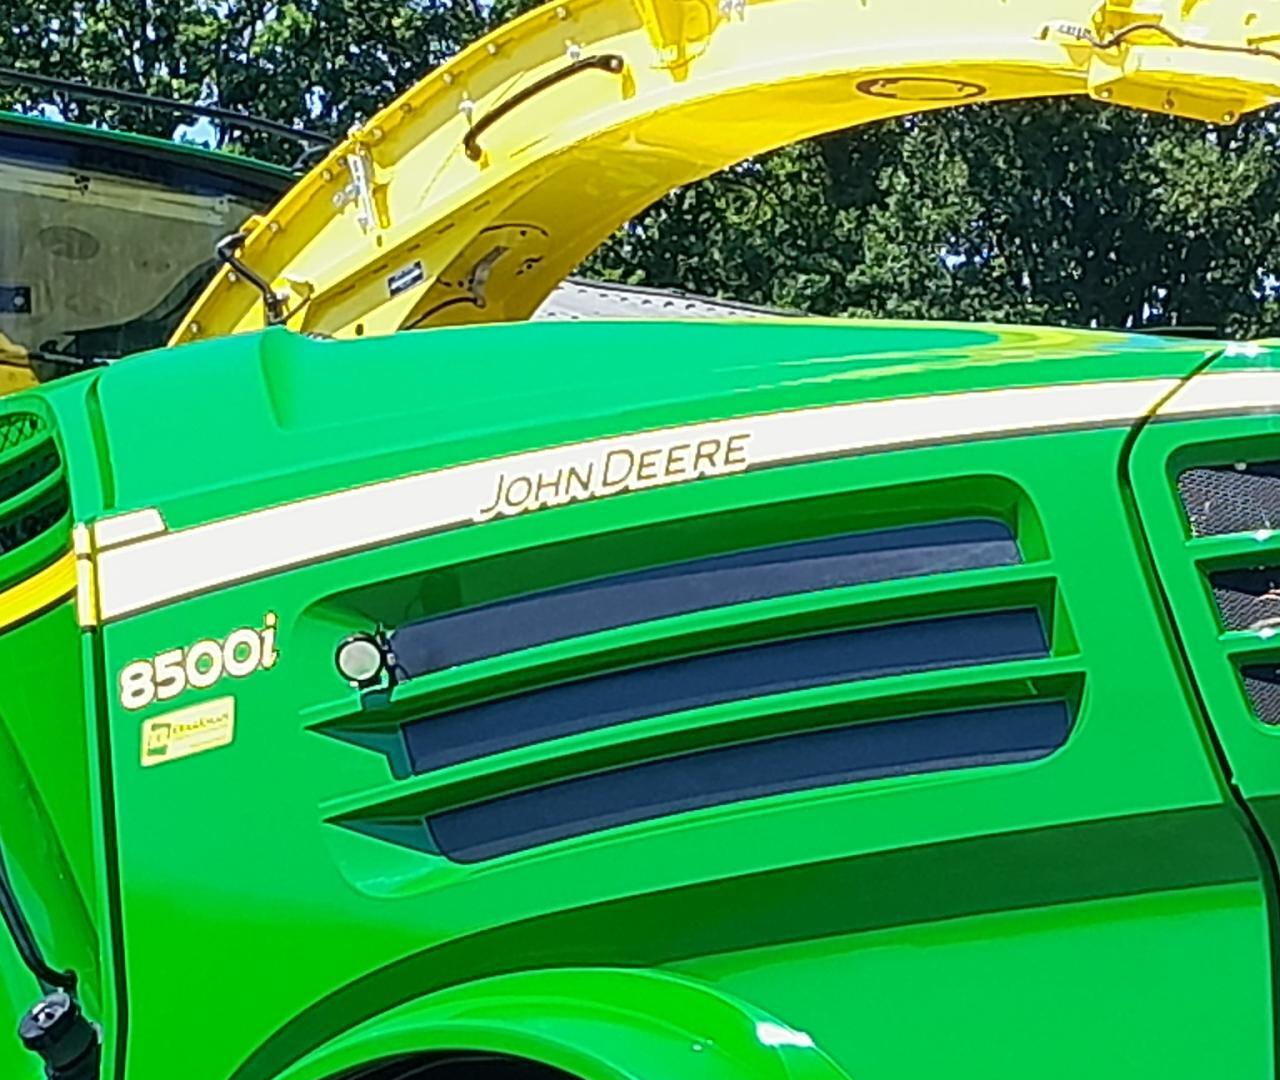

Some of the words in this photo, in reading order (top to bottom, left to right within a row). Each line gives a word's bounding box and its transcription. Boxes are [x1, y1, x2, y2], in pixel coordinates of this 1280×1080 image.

[479, 462, 594, 514] JOHN
[601, 433, 751, 489] DEERE
[119, 610, 279, 712] 8500i
